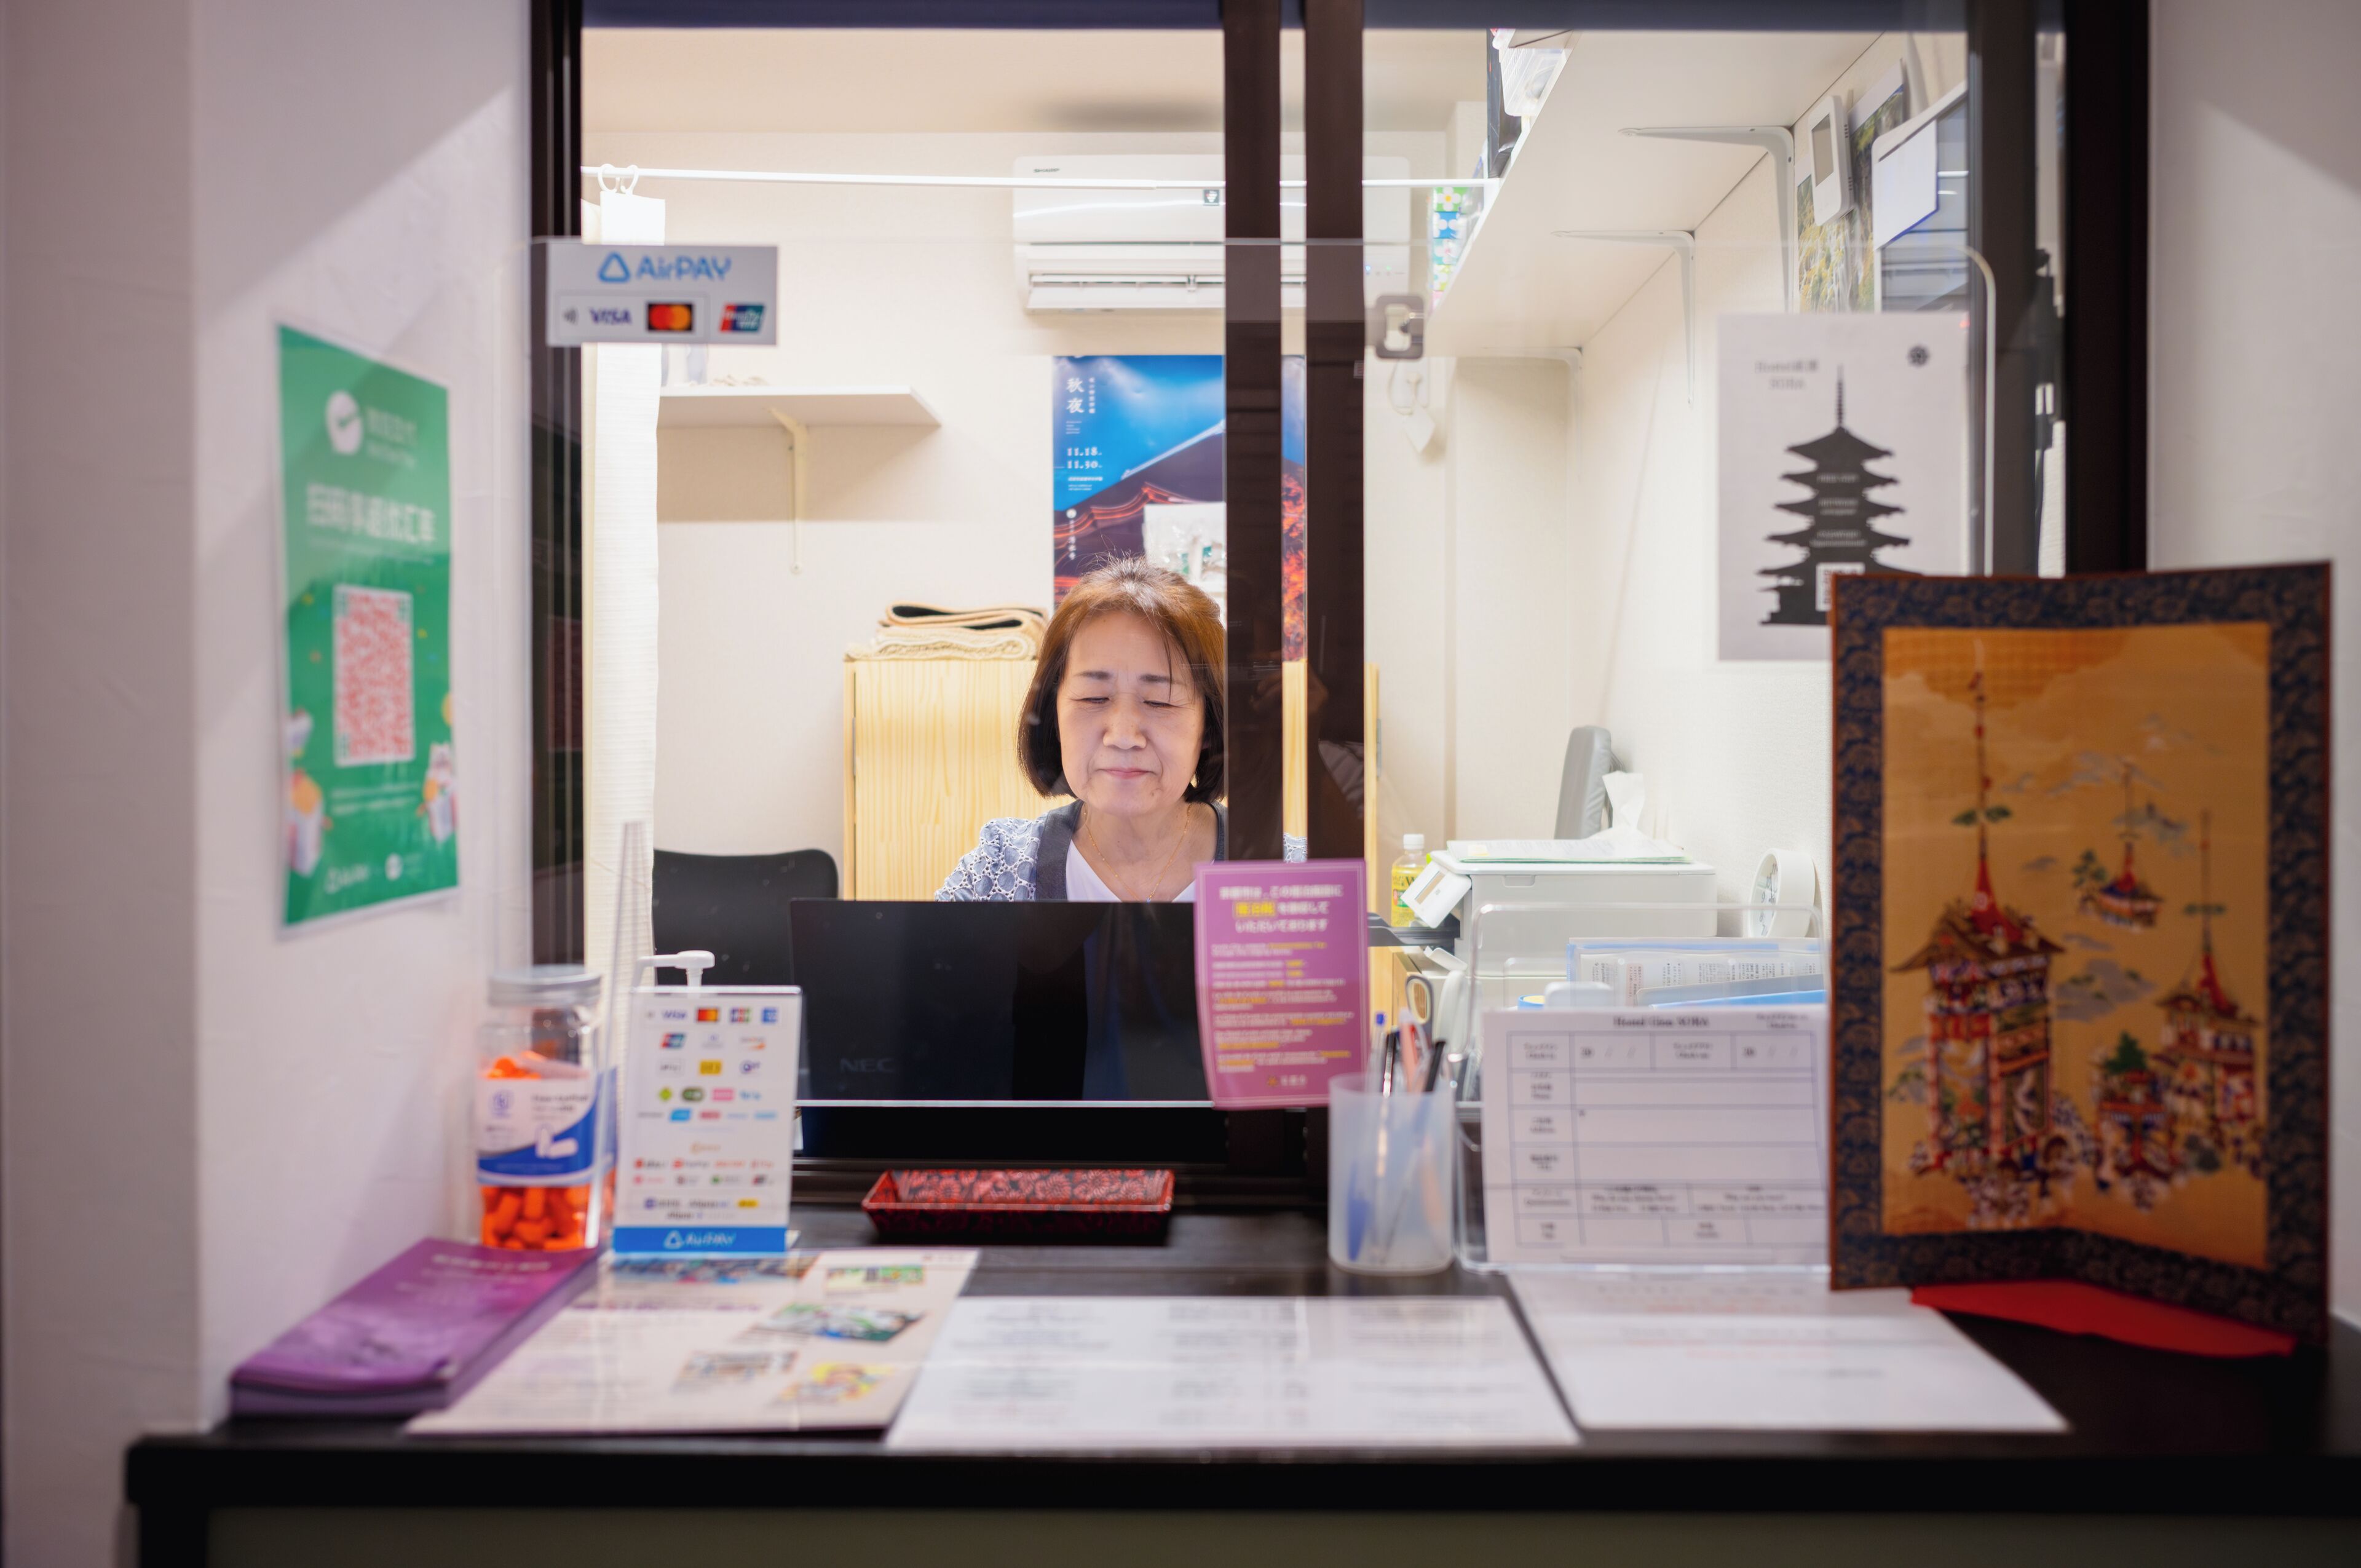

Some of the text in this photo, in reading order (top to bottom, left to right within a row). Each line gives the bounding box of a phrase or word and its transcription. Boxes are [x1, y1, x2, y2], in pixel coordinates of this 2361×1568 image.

[637, 255, 732, 280] AirPAY
[589, 308, 631, 324] VISA
[1067, 377, 1084, 414] 秋夜
[840, 1058, 896, 1072] NEC
